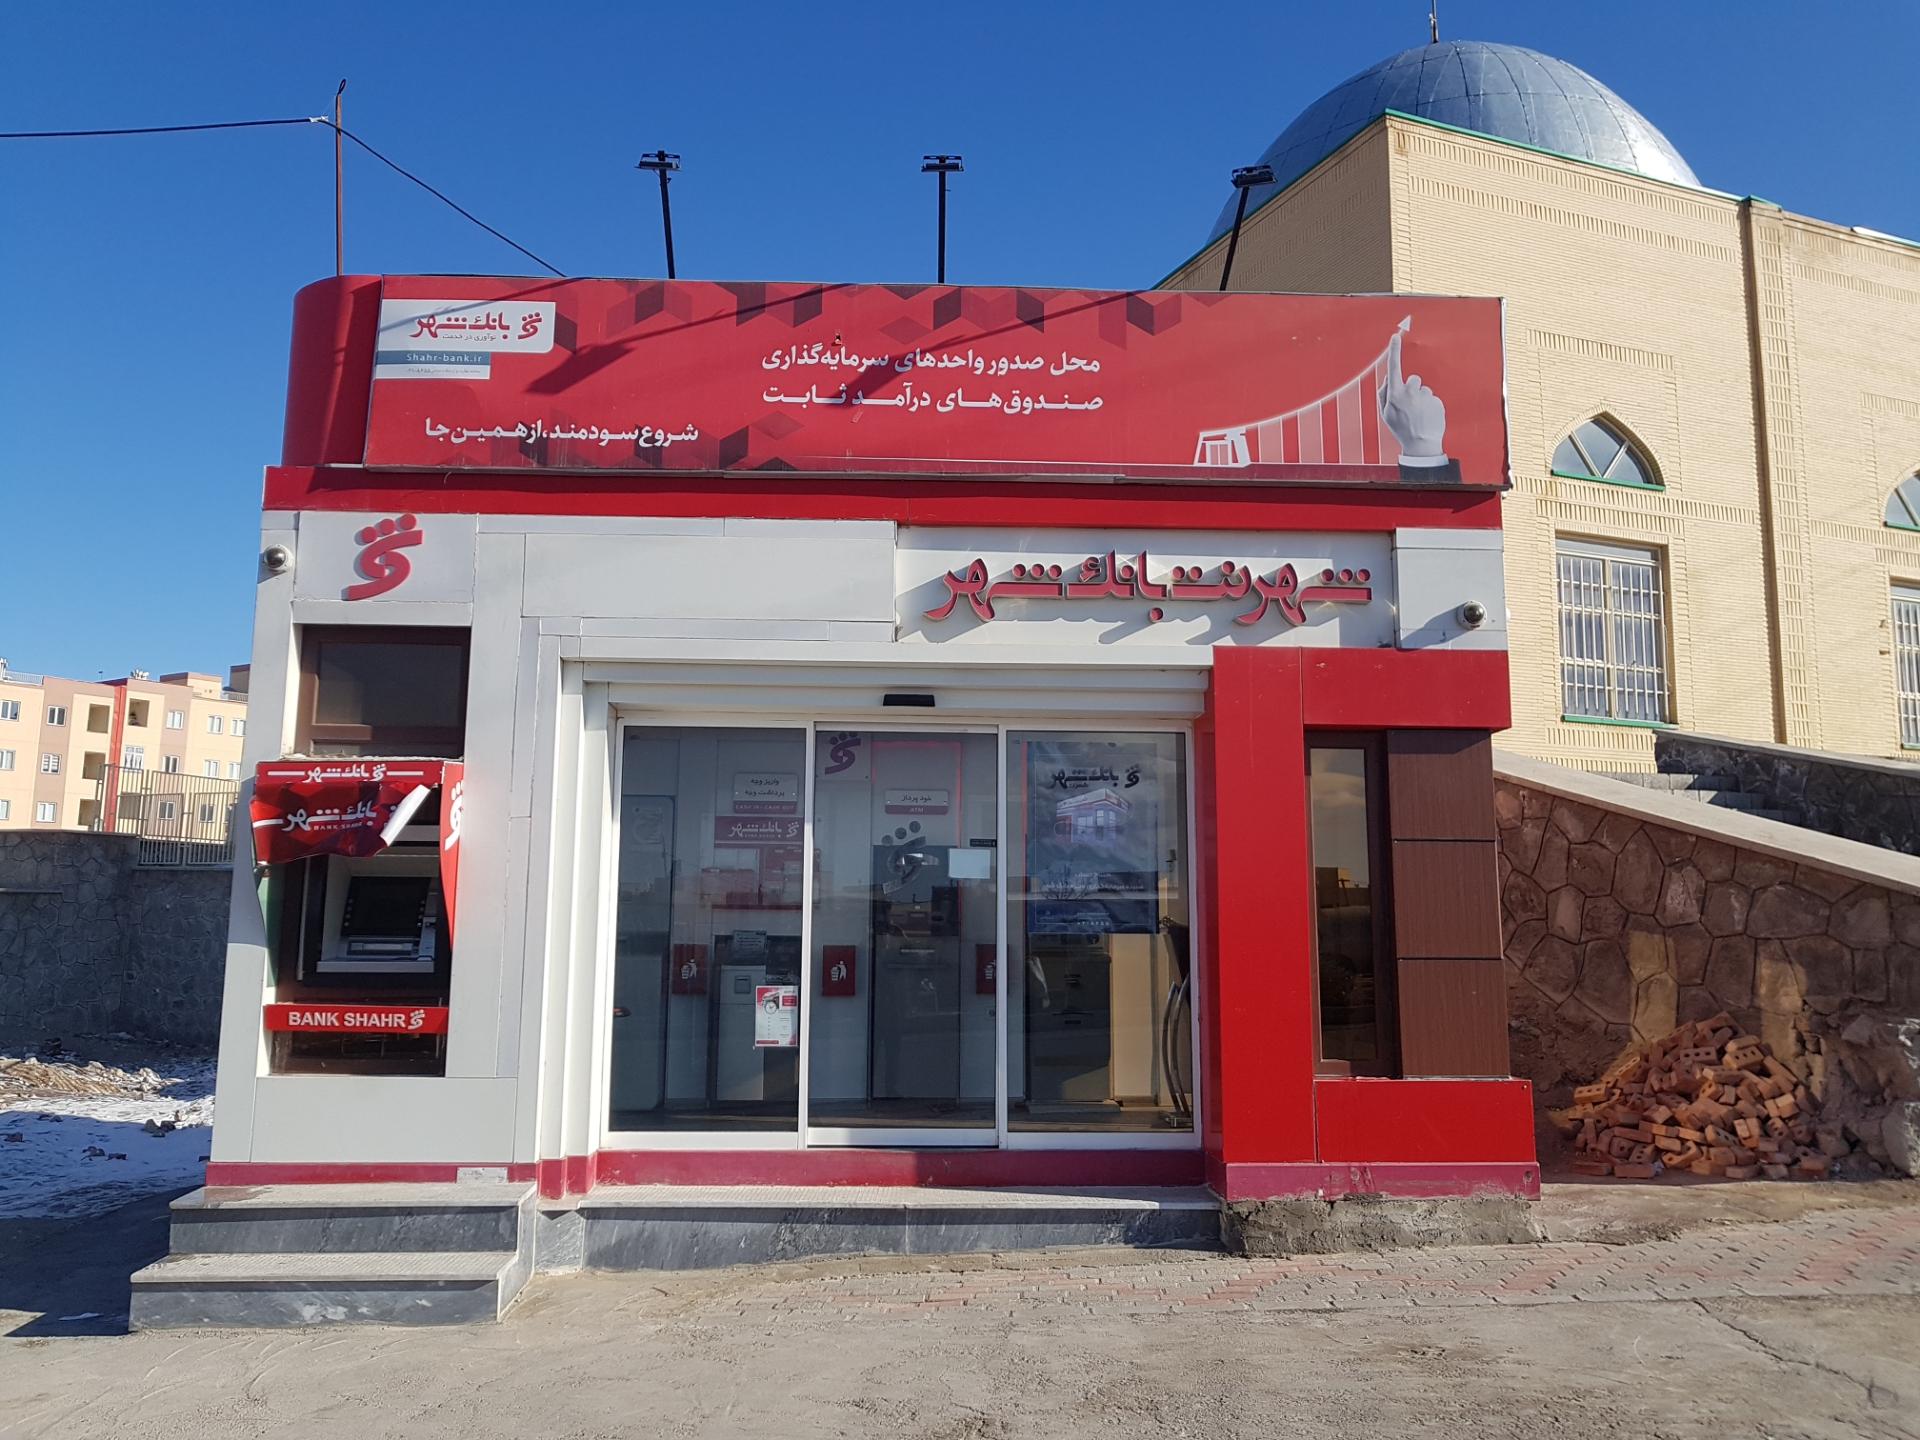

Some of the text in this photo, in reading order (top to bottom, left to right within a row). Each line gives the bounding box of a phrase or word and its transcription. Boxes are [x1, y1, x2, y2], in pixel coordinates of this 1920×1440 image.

[409, 313, 467, 338] شهر
[895, 347, 985, 375] واحدهای
[986, 354, 1045, 376] صدور
[1050, 351, 1101, 376] محل
[762, 383, 847, 409] ثابت
[852, 382, 931, 412] درآمد
[425, 416, 451, 442] جا
[450, 421, 529, 444] همین
[525, 418, 542, 444] از
[638, 423, 699, 448] شروع
[921, 557, 1065, 622] شهر
[302, 766, 341, 783] شهر
[281, 808, 341, 832] شهر
[728, 823, 759, 838] شهر
[288, 1011, 406, 1028] BANK SHAHR
